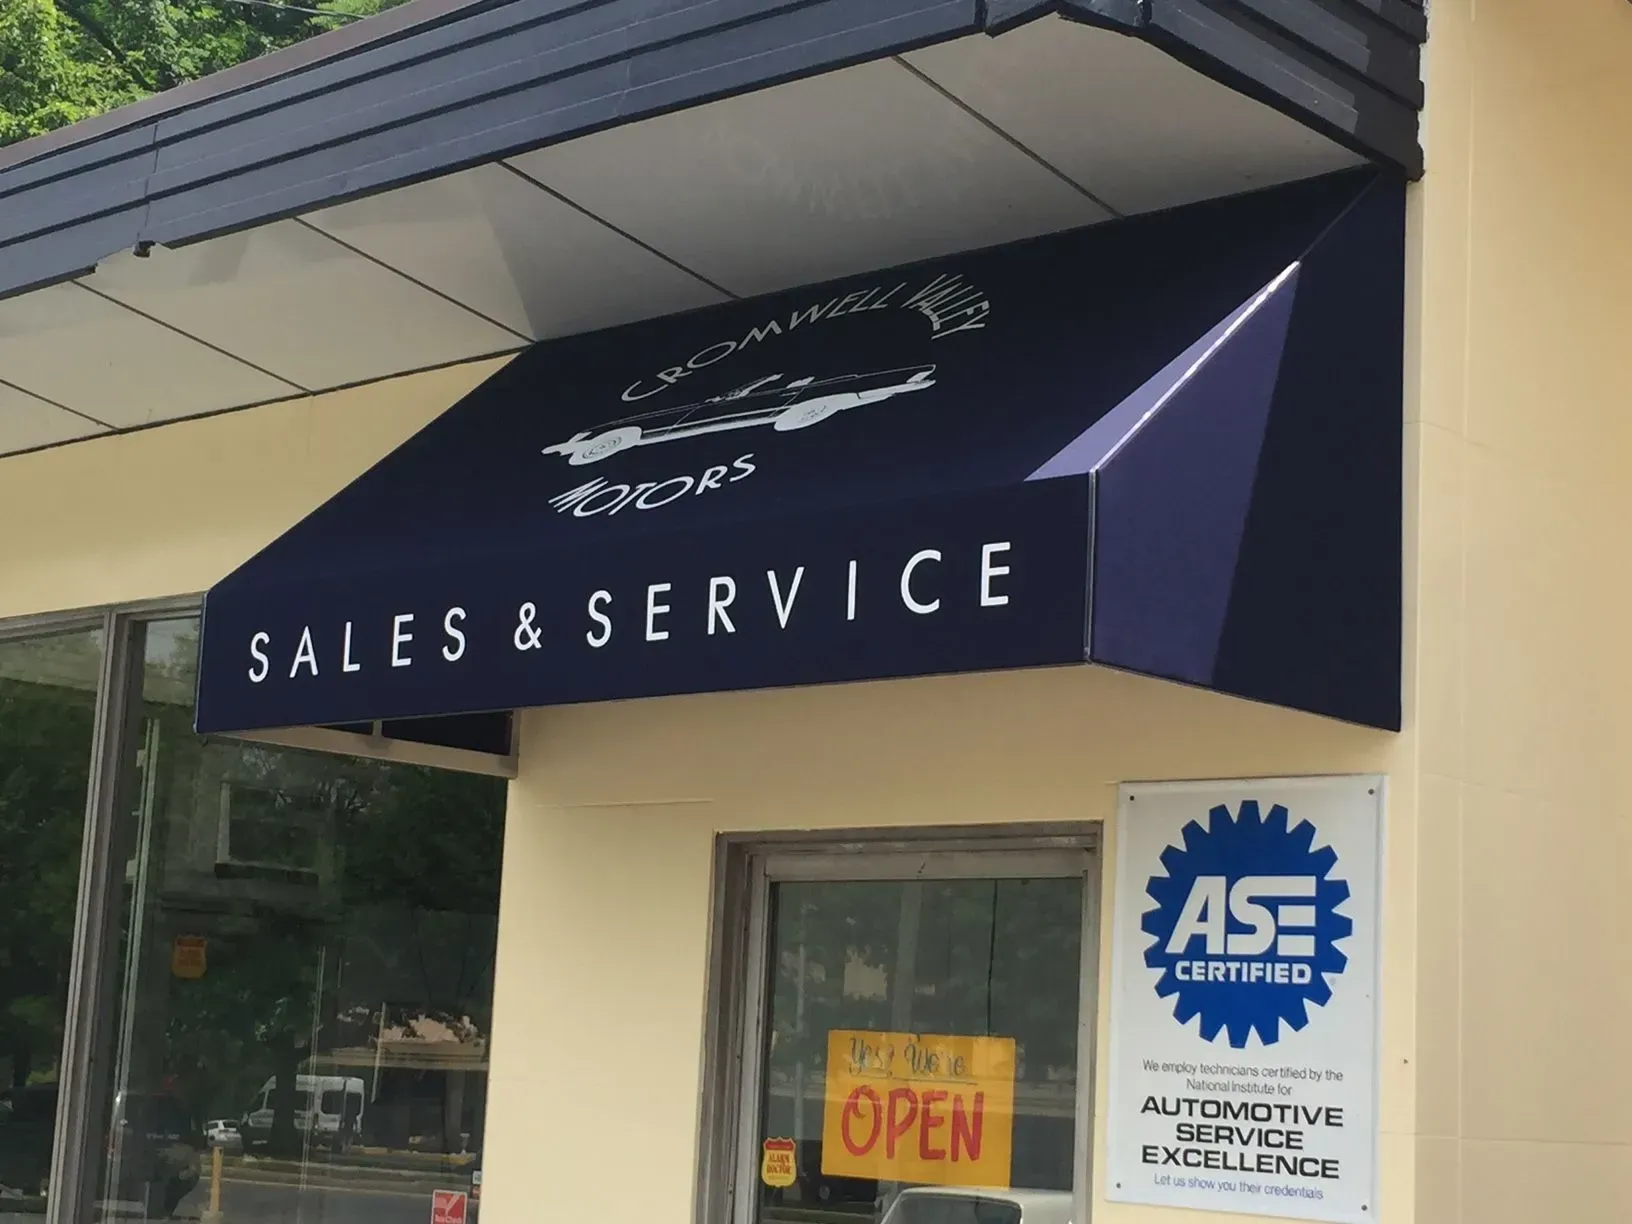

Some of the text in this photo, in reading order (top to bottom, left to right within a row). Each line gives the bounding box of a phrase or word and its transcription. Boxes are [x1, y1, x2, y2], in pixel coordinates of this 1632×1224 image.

[620, 273, 991, 401] CROMWELL VALLEY
[547, 453, 756, 517] MOTORS
[248, 541, 1012, 683] SALES & SERVICE
[1165, 875, 1317, 957] ASE
[1174, 960, 1312, 984] CERTIFIED
[1143, 1059, 1344, 1082] We employ technicians certified by the
[1186, 1078, 1293, 1095] National Institute for
[841, 1084, 984, 1162] OPEN
[1140, 1096, 1344, 1127] AUTOMOTIVE
[1176, 1122, 1304, 1150] SERVICE
[1141, 1144, 1340, 1179] EXCELLENCE
[1154, 1173, 1324, 1199] Let us show you their credentials
